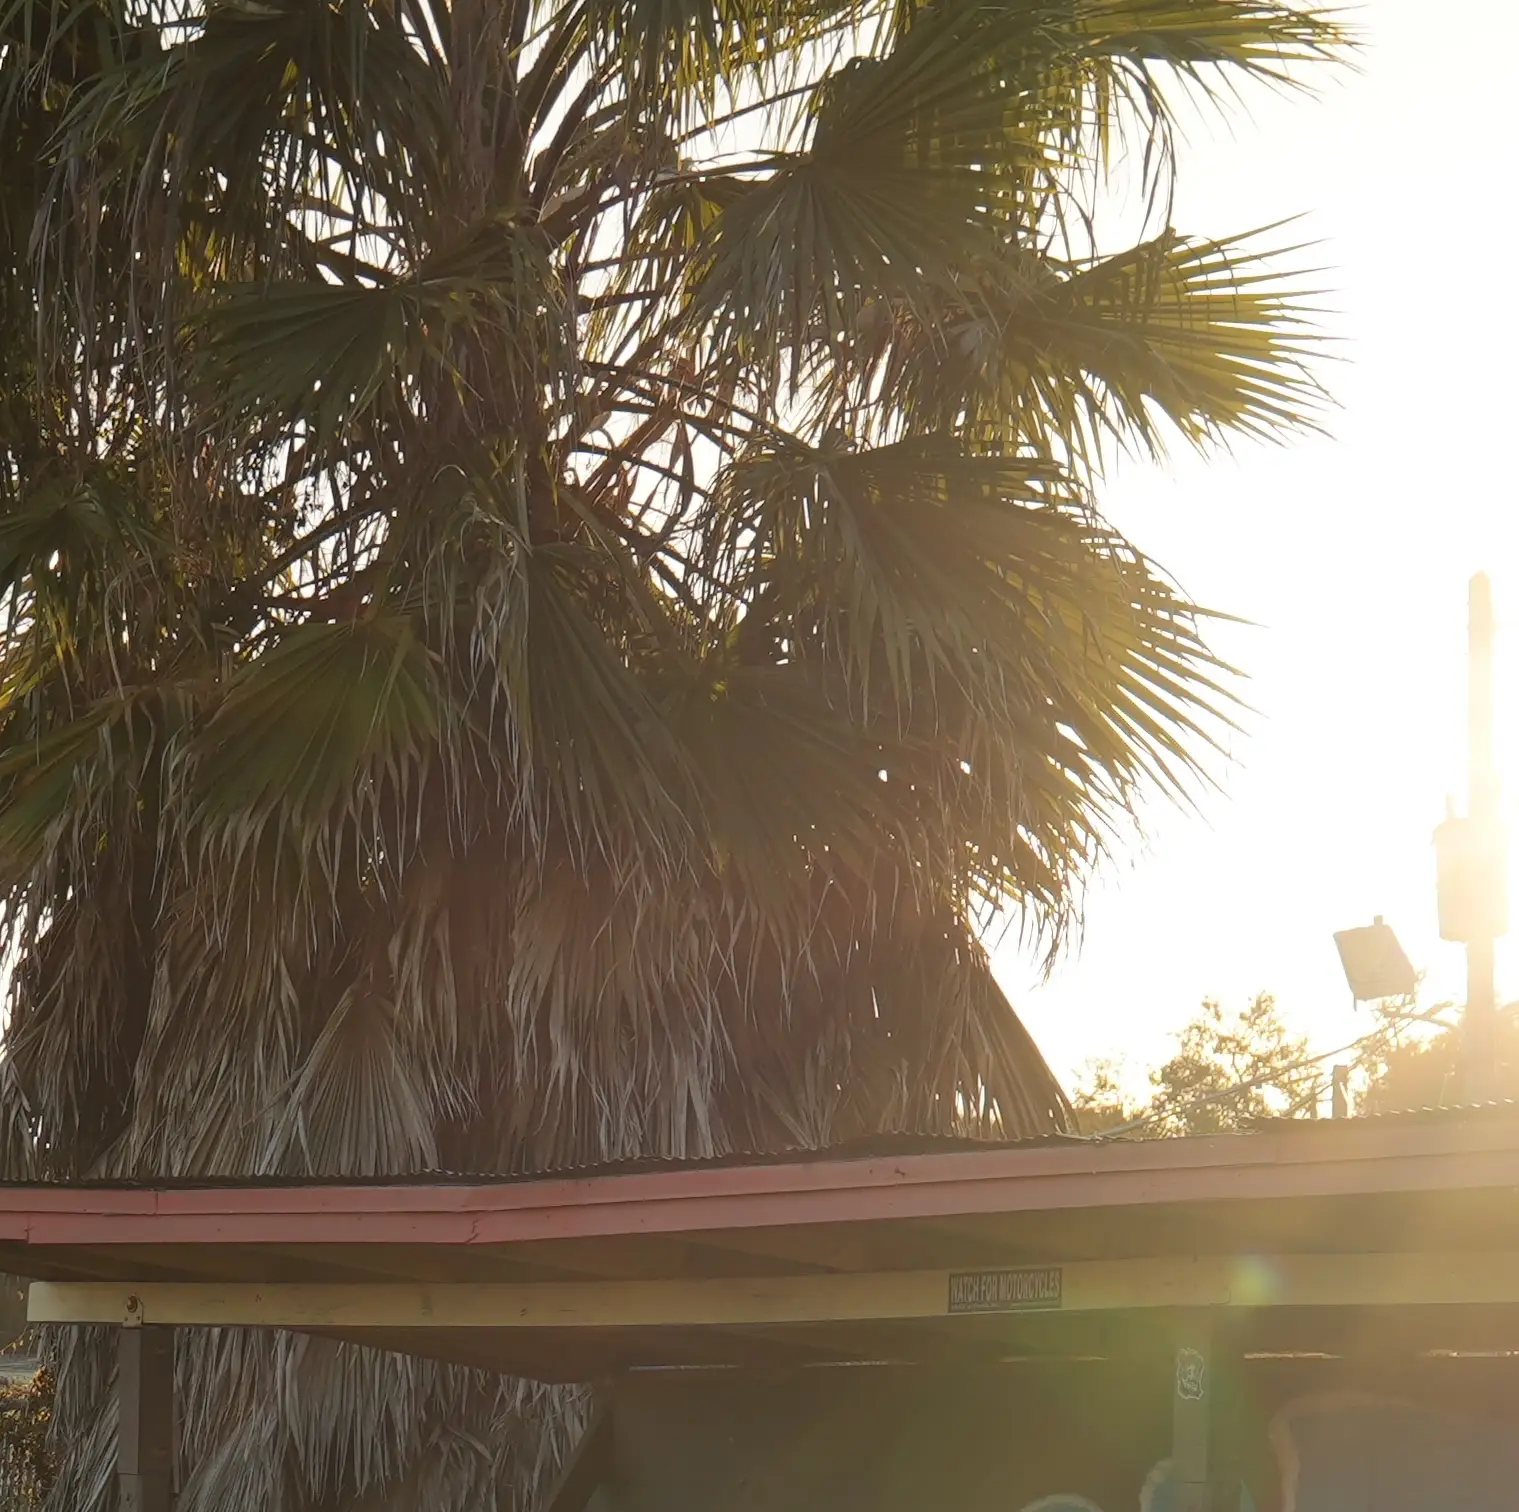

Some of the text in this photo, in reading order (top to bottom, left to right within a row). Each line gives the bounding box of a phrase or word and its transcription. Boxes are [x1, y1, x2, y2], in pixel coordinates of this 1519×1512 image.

[950, 1270, 1060, 1303] WATCH FOR MOTORCYCLES
